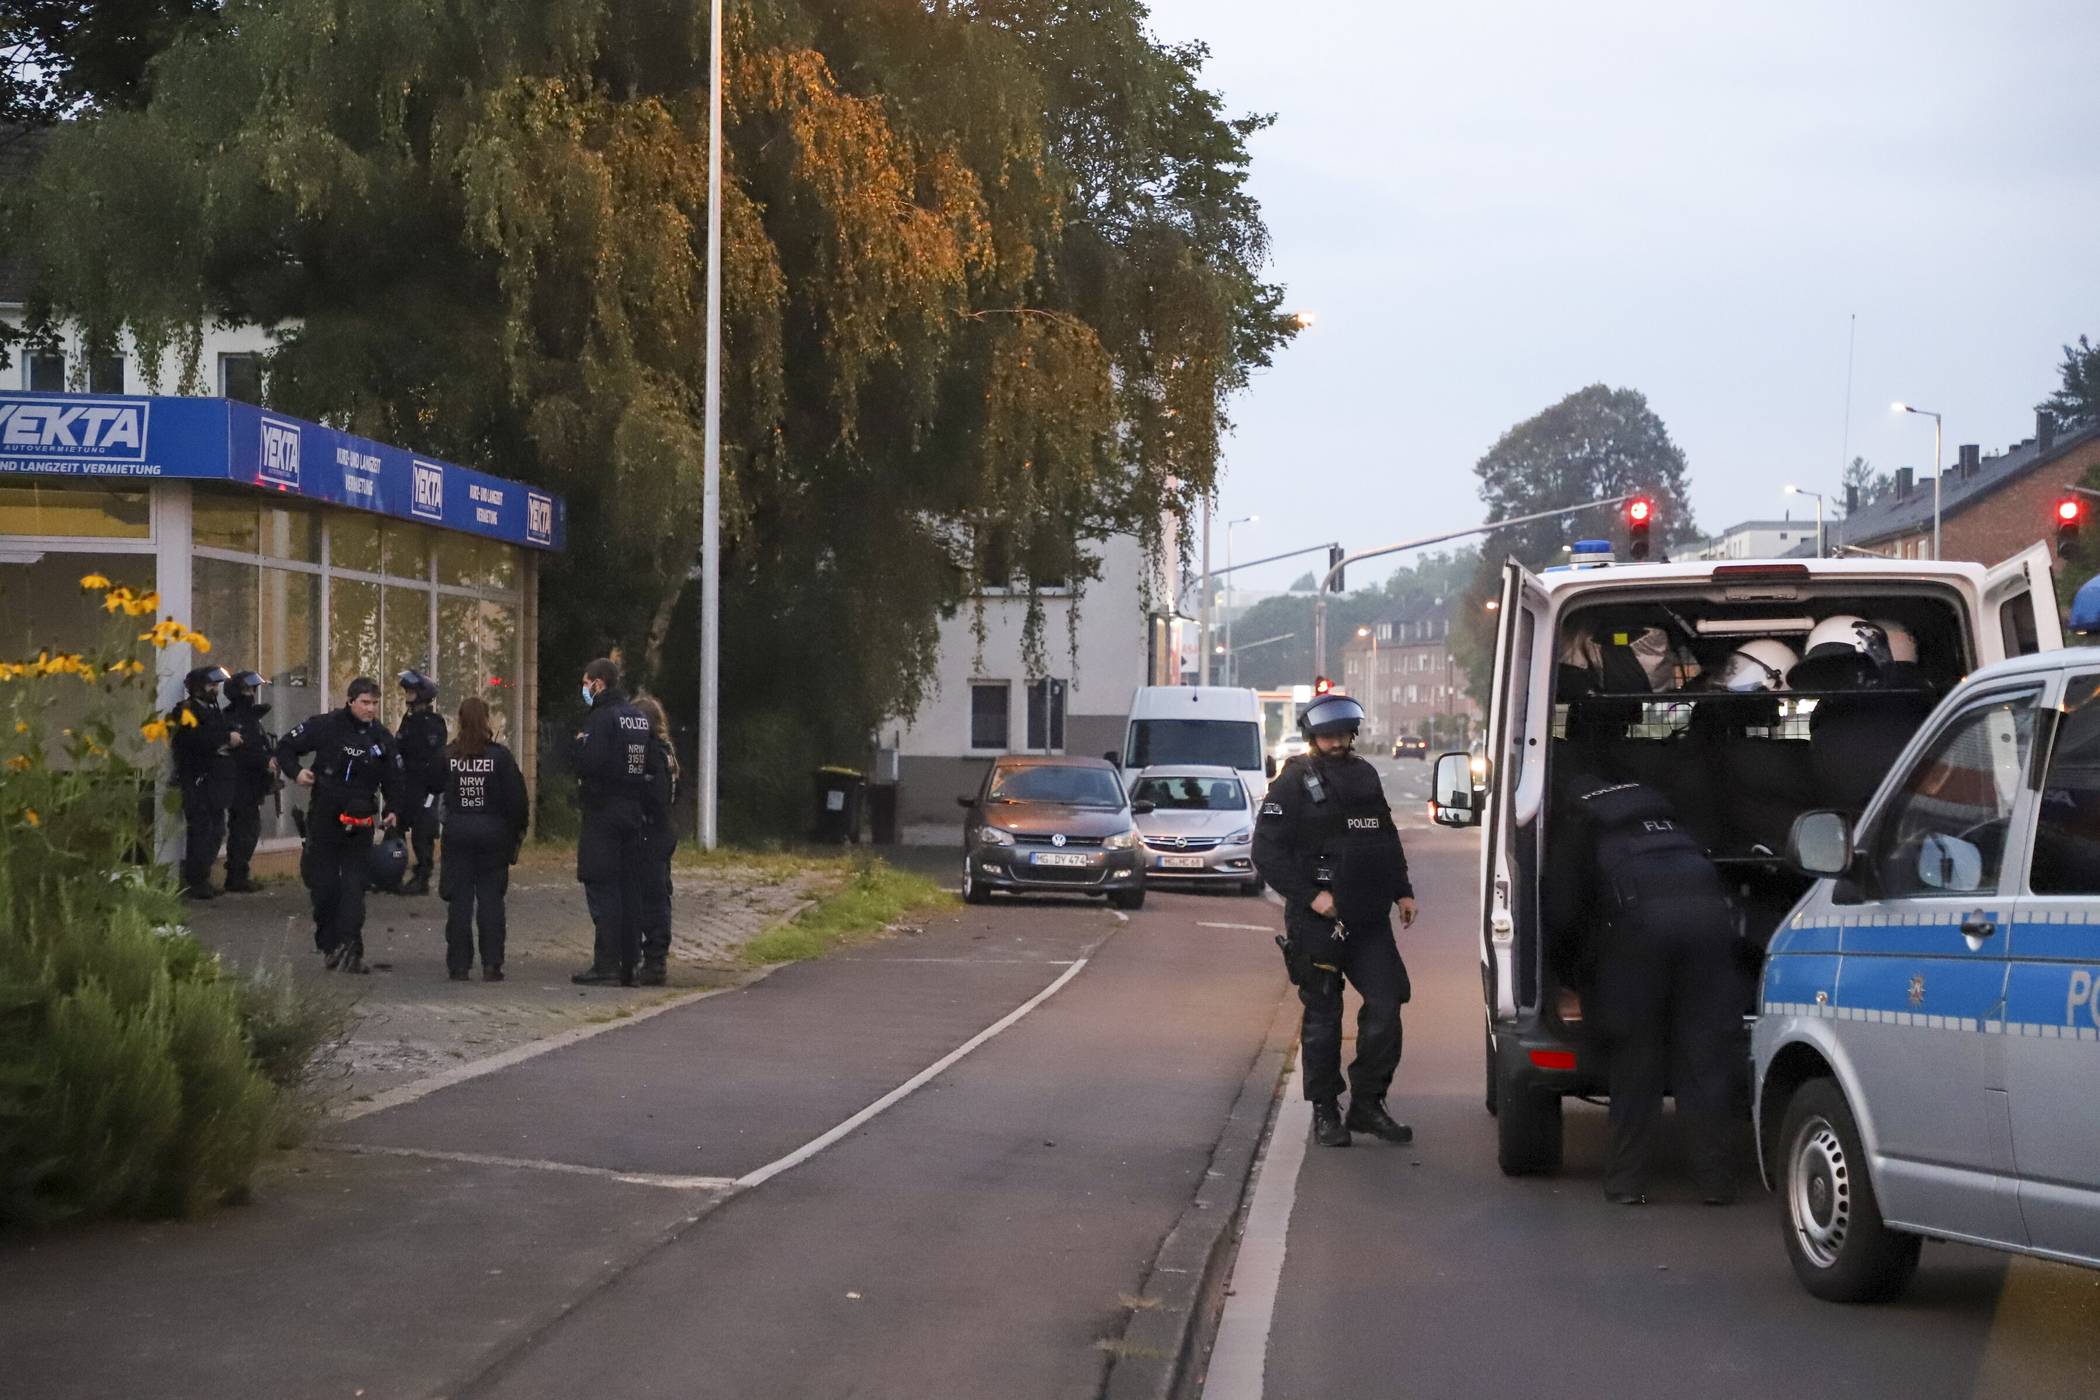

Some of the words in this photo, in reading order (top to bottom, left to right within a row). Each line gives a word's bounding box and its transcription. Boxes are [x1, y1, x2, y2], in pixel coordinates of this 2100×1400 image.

[4, 444, 106, 454] AUTOVERMIETUNG
[263, 425, 298, 473] YEKTA
[20, 462, 80, 473] LANGZEIT
[83, 463, 161, 475] VERMIETUNG
[414, 466, 441, 508] YEKTA
[529, 498, 550, 535] YEKTA
[619, 716, 649, 730] POLIZEI
[628, 744, 645, 754] NRW
[450, 758, 495, 772] POLIZEI
[460, 776, 485, 786] NRW
[459, 786, 484, 797] 31511
[461, 796, 484, 807] BeSi
[1347, 818, 1380, 829] POLIZEI
[1037, 854, 1049, 864] MG
[1055, 855, 1067, 864] DY
[1068, 855, 1085, 865] 474
